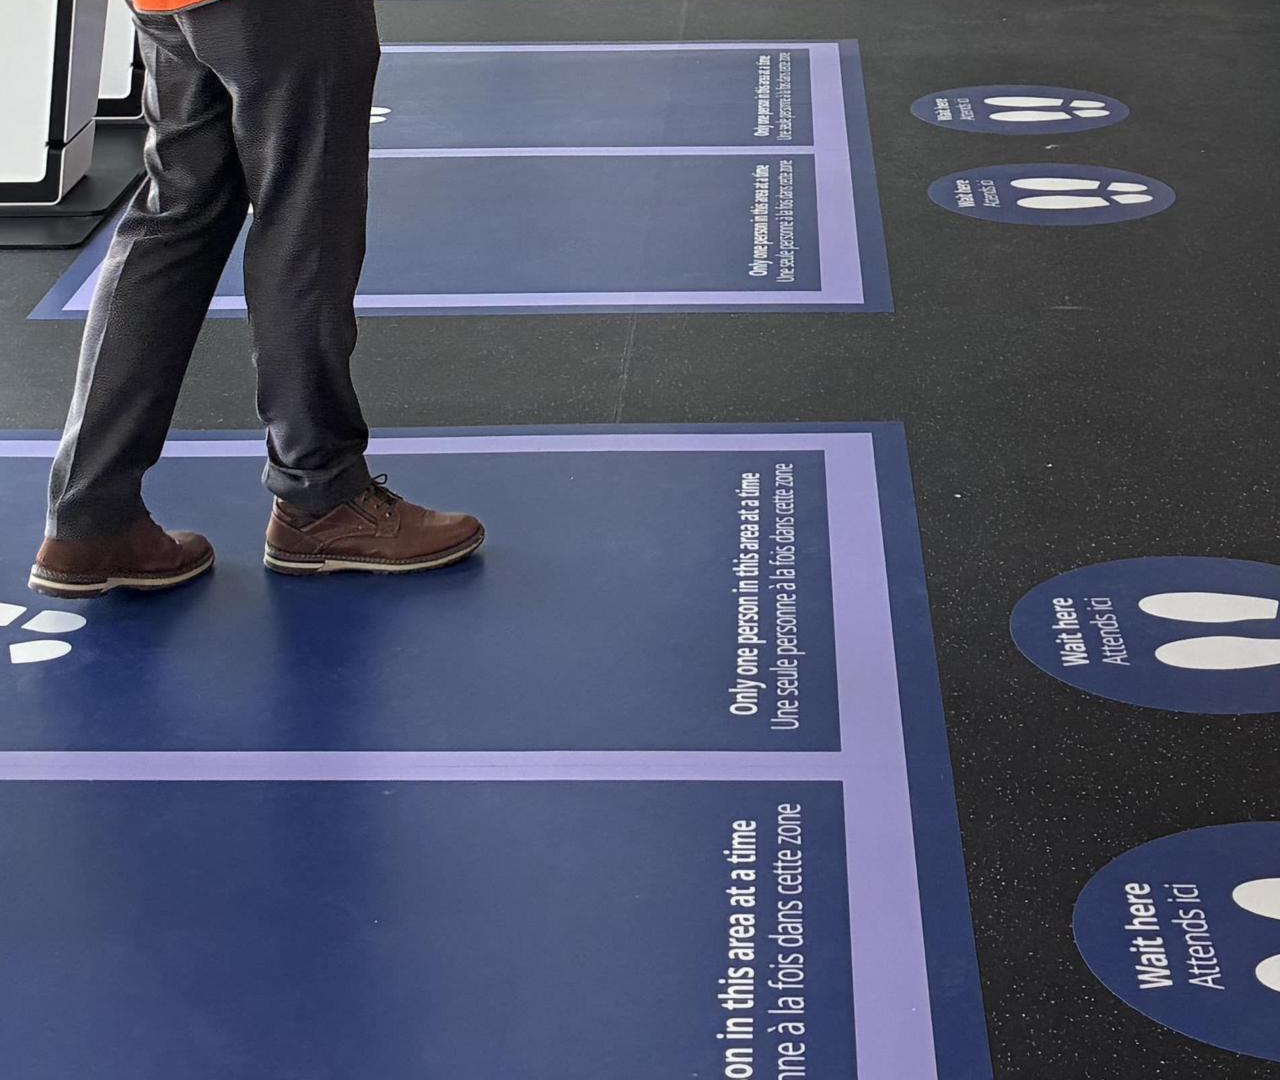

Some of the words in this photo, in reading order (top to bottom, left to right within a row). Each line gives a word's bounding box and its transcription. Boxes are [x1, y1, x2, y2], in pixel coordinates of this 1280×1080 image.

[751, 165, 769, 177] time
[754, 190, 769, 202] area
[954, 180, 972, 193] here
[750, 203, 768, 214] this
[955, 194, 975, 207] Wait
[753, 223, 773, 245] person
[753, 246, 768, 258] one
[748, 260, 773, 276] Only
[735, 472, 760, 497] time
[774, 463, 794, 487] zone
[772, 489, 794, 514] cette
[737, 509, 759, 521] at
[738, 525, 759, 550] area
[769, 517, 795, 543] dans
[732, 553, 759, 577] this
[768, 545, 795, 566] fois
[732, 580, 758, 592] in
[771, 569, 795, 579] la
[1052, 597, 1080, 629] here
[1083, 597, 1113, 610] ici
[736, 596, 766, 643] person
[776, 594, 805, 655] personne
[1055, 632, 1090, 667] Wait
[1089, 613, 1131, 666] Attends
[737, 648, 758, 675] one
[769, 659, 798, 696] seule
[729, 679, 766, 716] Only
[770, 700, 799, 730] Une
[776, 803, 802, 845] zone
[723, 820, 756, 863] time
[730, 869, 756, 881] a
[772, 850, 802, 895] cette
[725, 886, 756, 907] at
[1163, 884, 1201, 902] ici
[1124, 882, 1160, 930] here
[768, 901, 803, 947] dans
[725, 913, 756, 961] area
[1171, 909, 1225, 990] Attends
[767, 954, 804, 989] fois
[1129, 936, 1174, 989] Wait
[717, 967, 755, 1010] this
[768, 997, 804, 1014] la
[716, 1017, 754, 1039] in
[767, 1023, 805, 1035] à
[724, 1048, 754, 1080] on
[774, 1042, 805, 1080] nne
